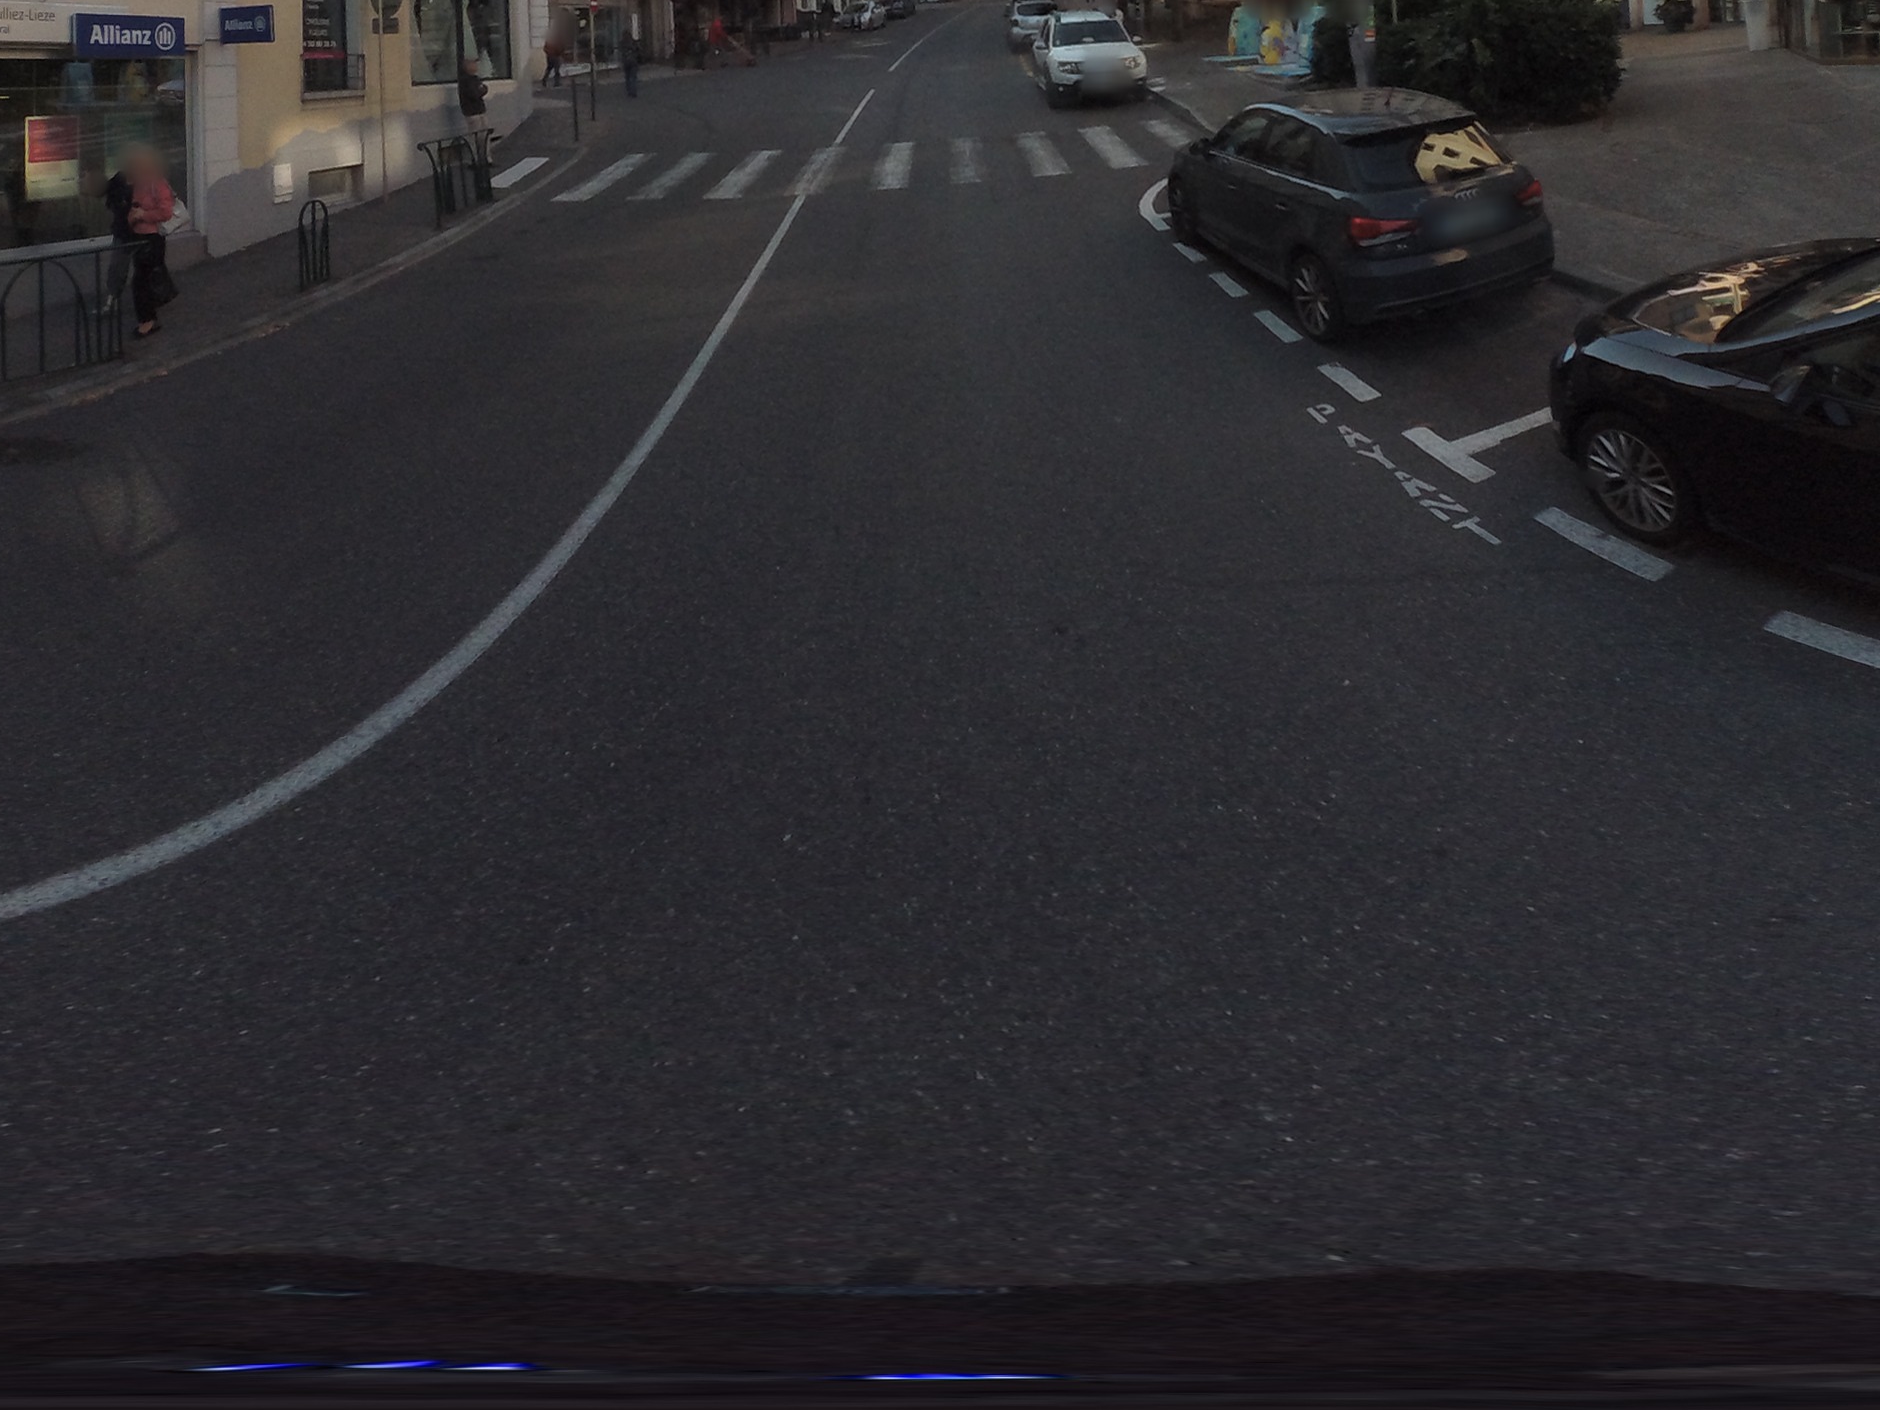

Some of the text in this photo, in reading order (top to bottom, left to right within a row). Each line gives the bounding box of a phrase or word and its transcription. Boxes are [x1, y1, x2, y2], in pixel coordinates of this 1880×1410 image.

[90, 23, 152, 45] Allianz
[224, 19, 254, 31] Allianz
[1306, 403, 1502, 545] PAYANT
